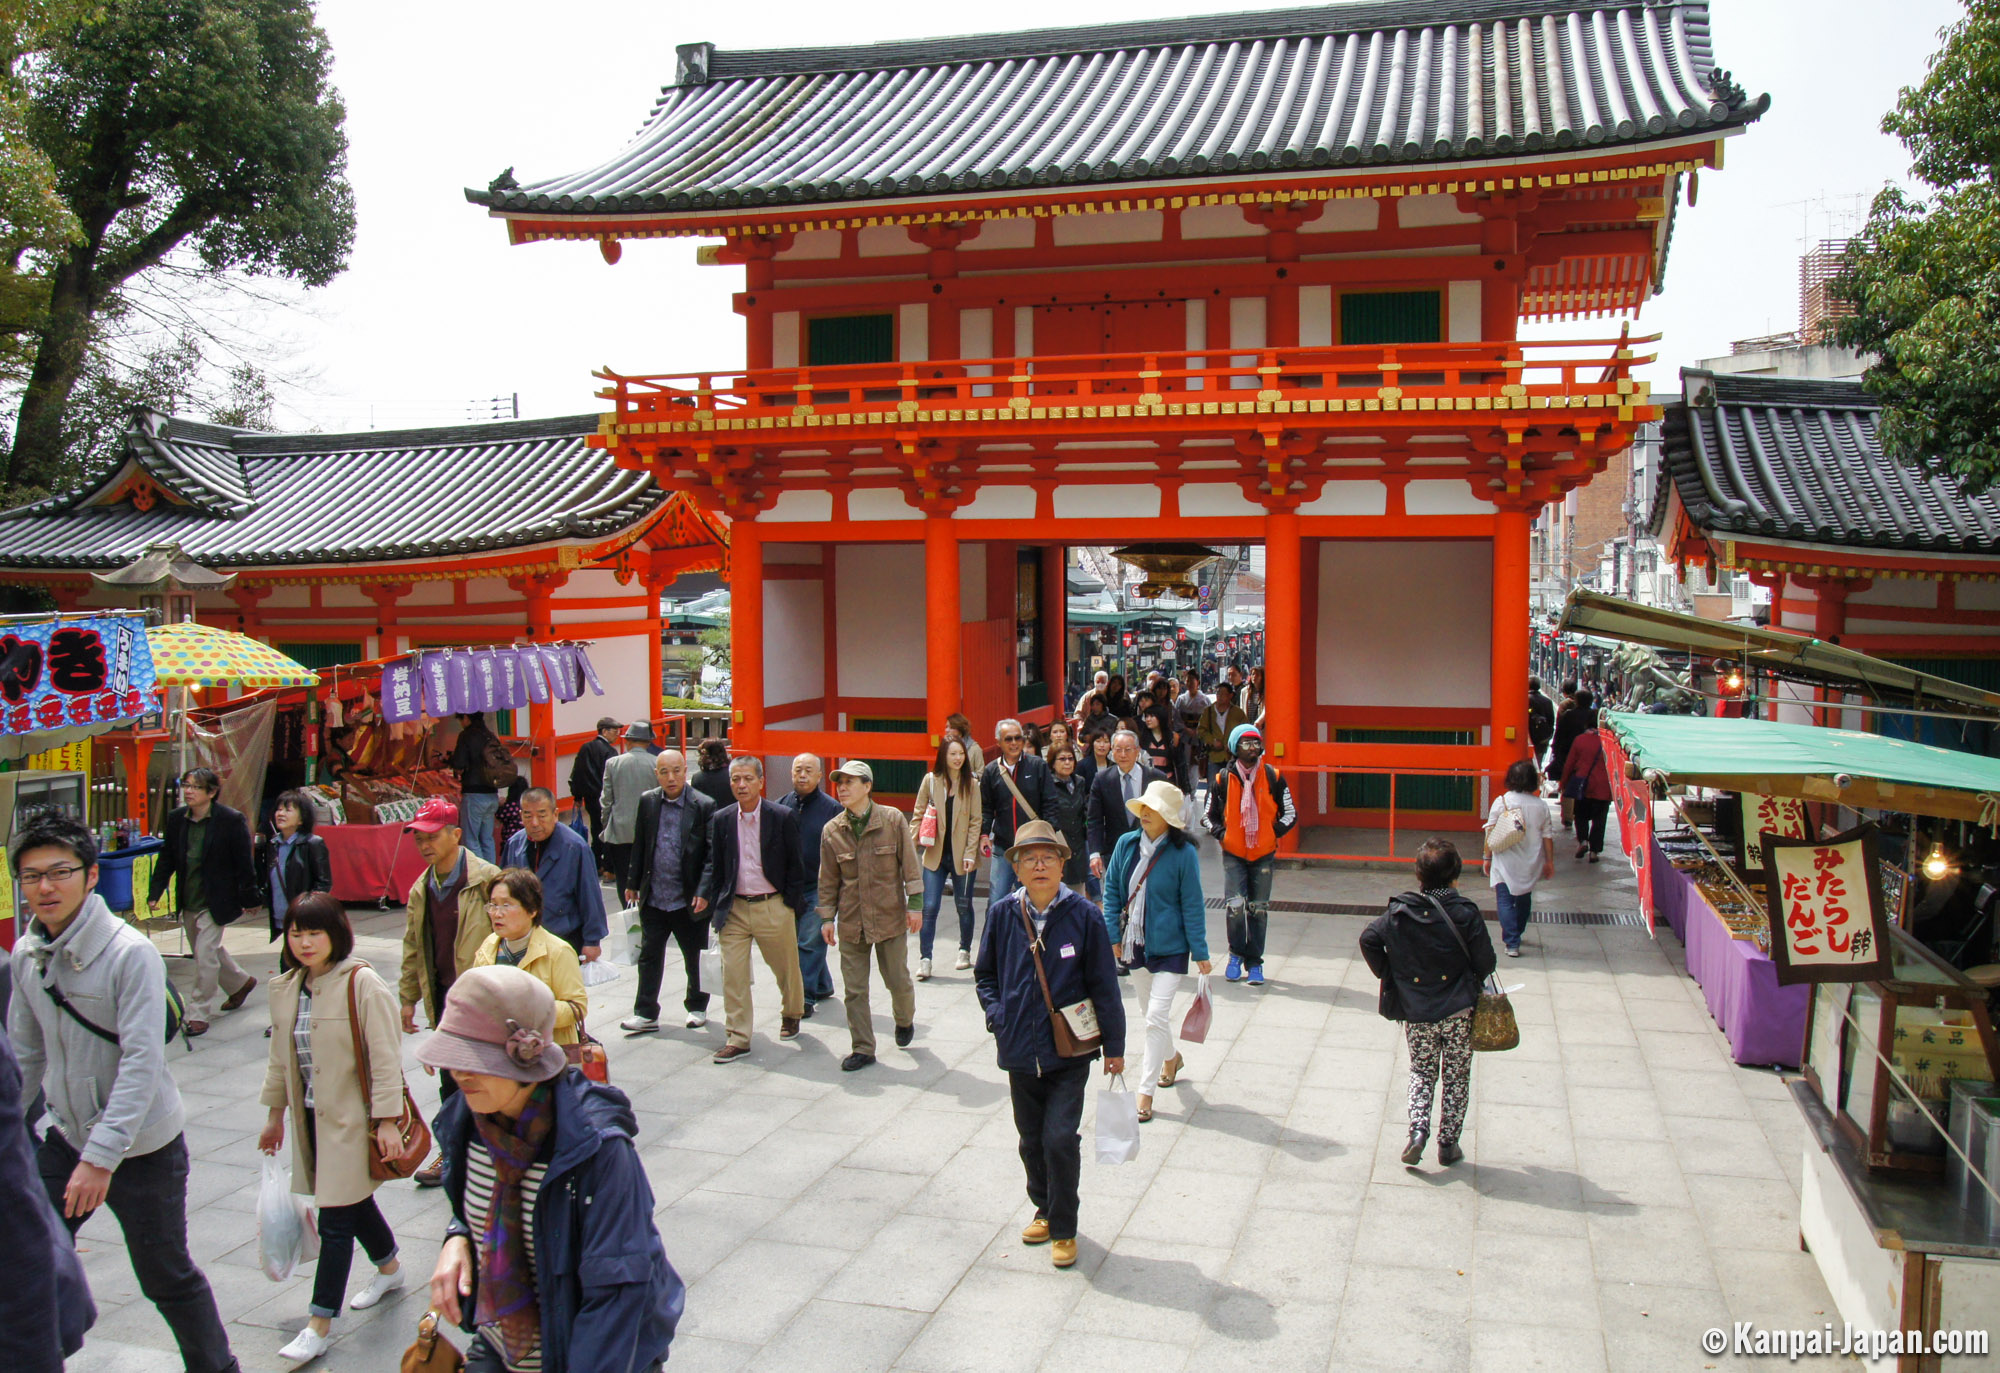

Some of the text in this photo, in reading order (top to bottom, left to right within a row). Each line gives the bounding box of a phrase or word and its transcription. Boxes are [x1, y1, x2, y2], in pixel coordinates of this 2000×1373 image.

[1782, 872, 1823, 955] だんご
[1813, 847, 1850, 953] みたらし
